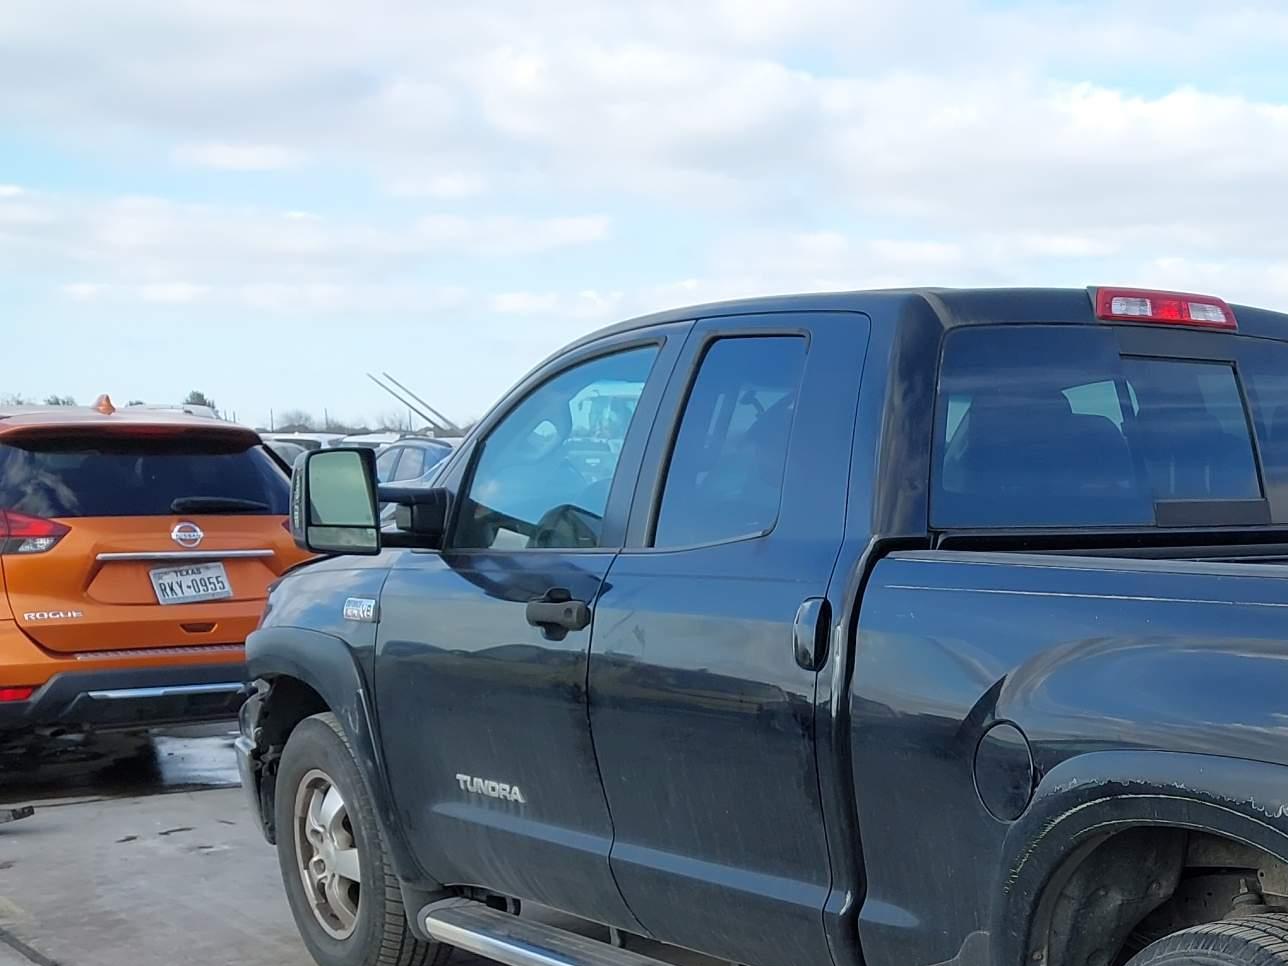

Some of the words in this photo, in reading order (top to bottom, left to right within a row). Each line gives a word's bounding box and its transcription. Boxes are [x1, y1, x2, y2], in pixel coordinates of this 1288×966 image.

[175, 567, 203, 577] TEXAS
[23, 611, 83, 621] ROGUE
[456, 773, 526, 803] TUNDRA
